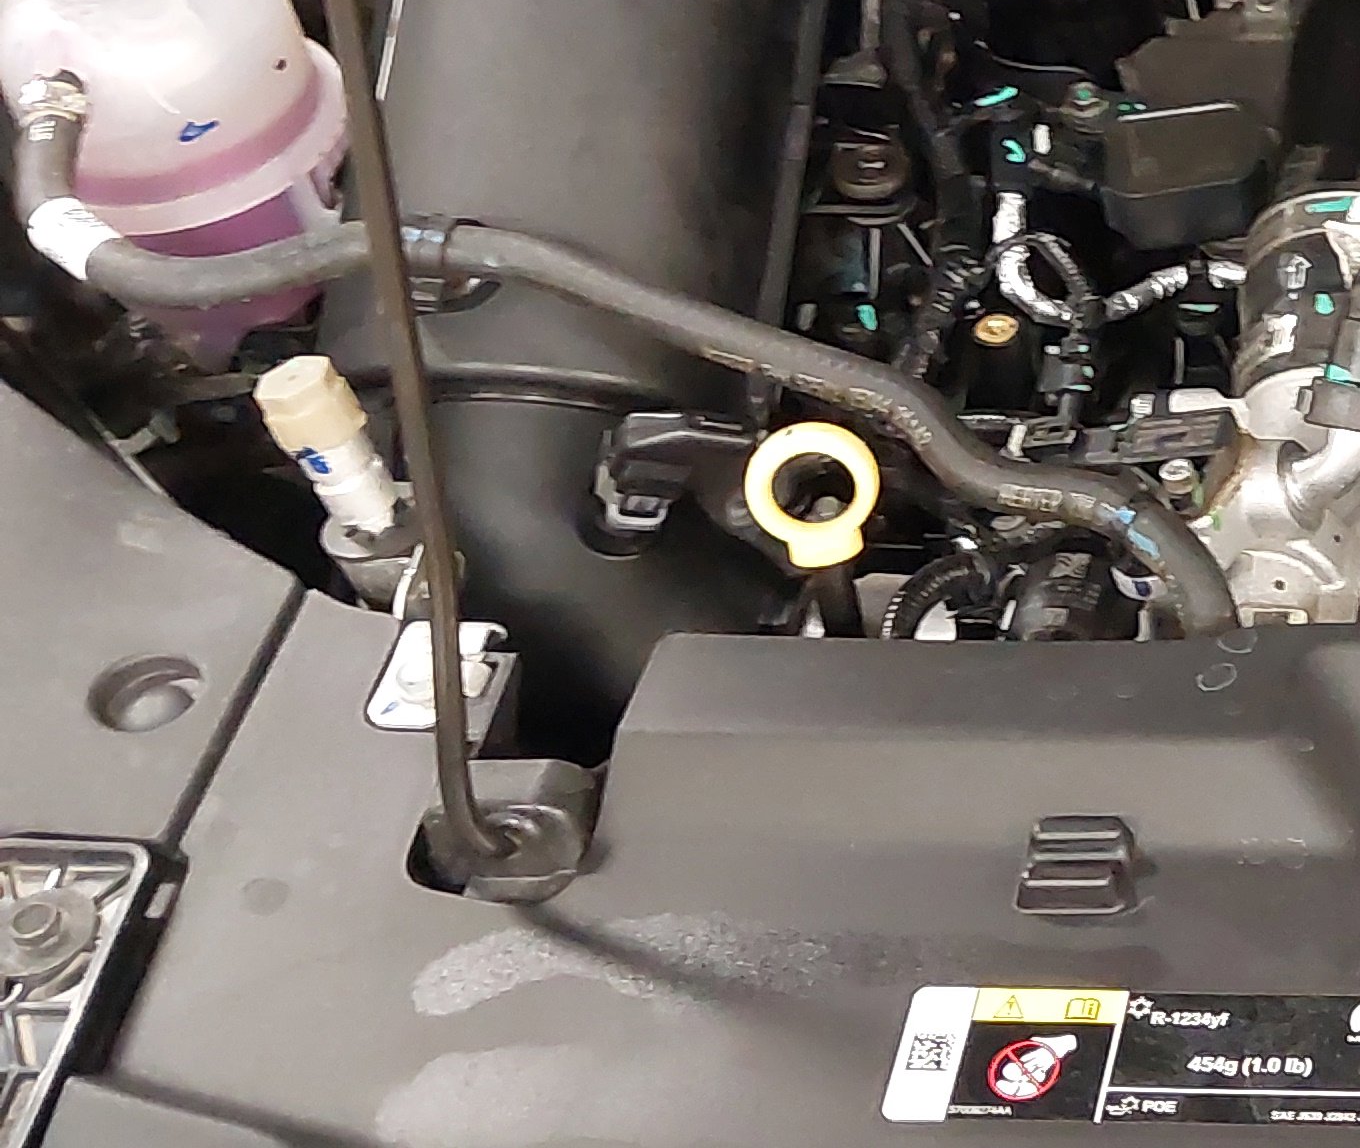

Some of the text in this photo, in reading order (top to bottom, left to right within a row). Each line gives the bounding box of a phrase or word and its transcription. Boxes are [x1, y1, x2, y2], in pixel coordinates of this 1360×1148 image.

[1150, 1010, 1230, 1030] R-1234yf
[1186, 1055, 1315, 1078] 454g (1.0 lb)
[1141, 1099, 1179, 1115] POE
